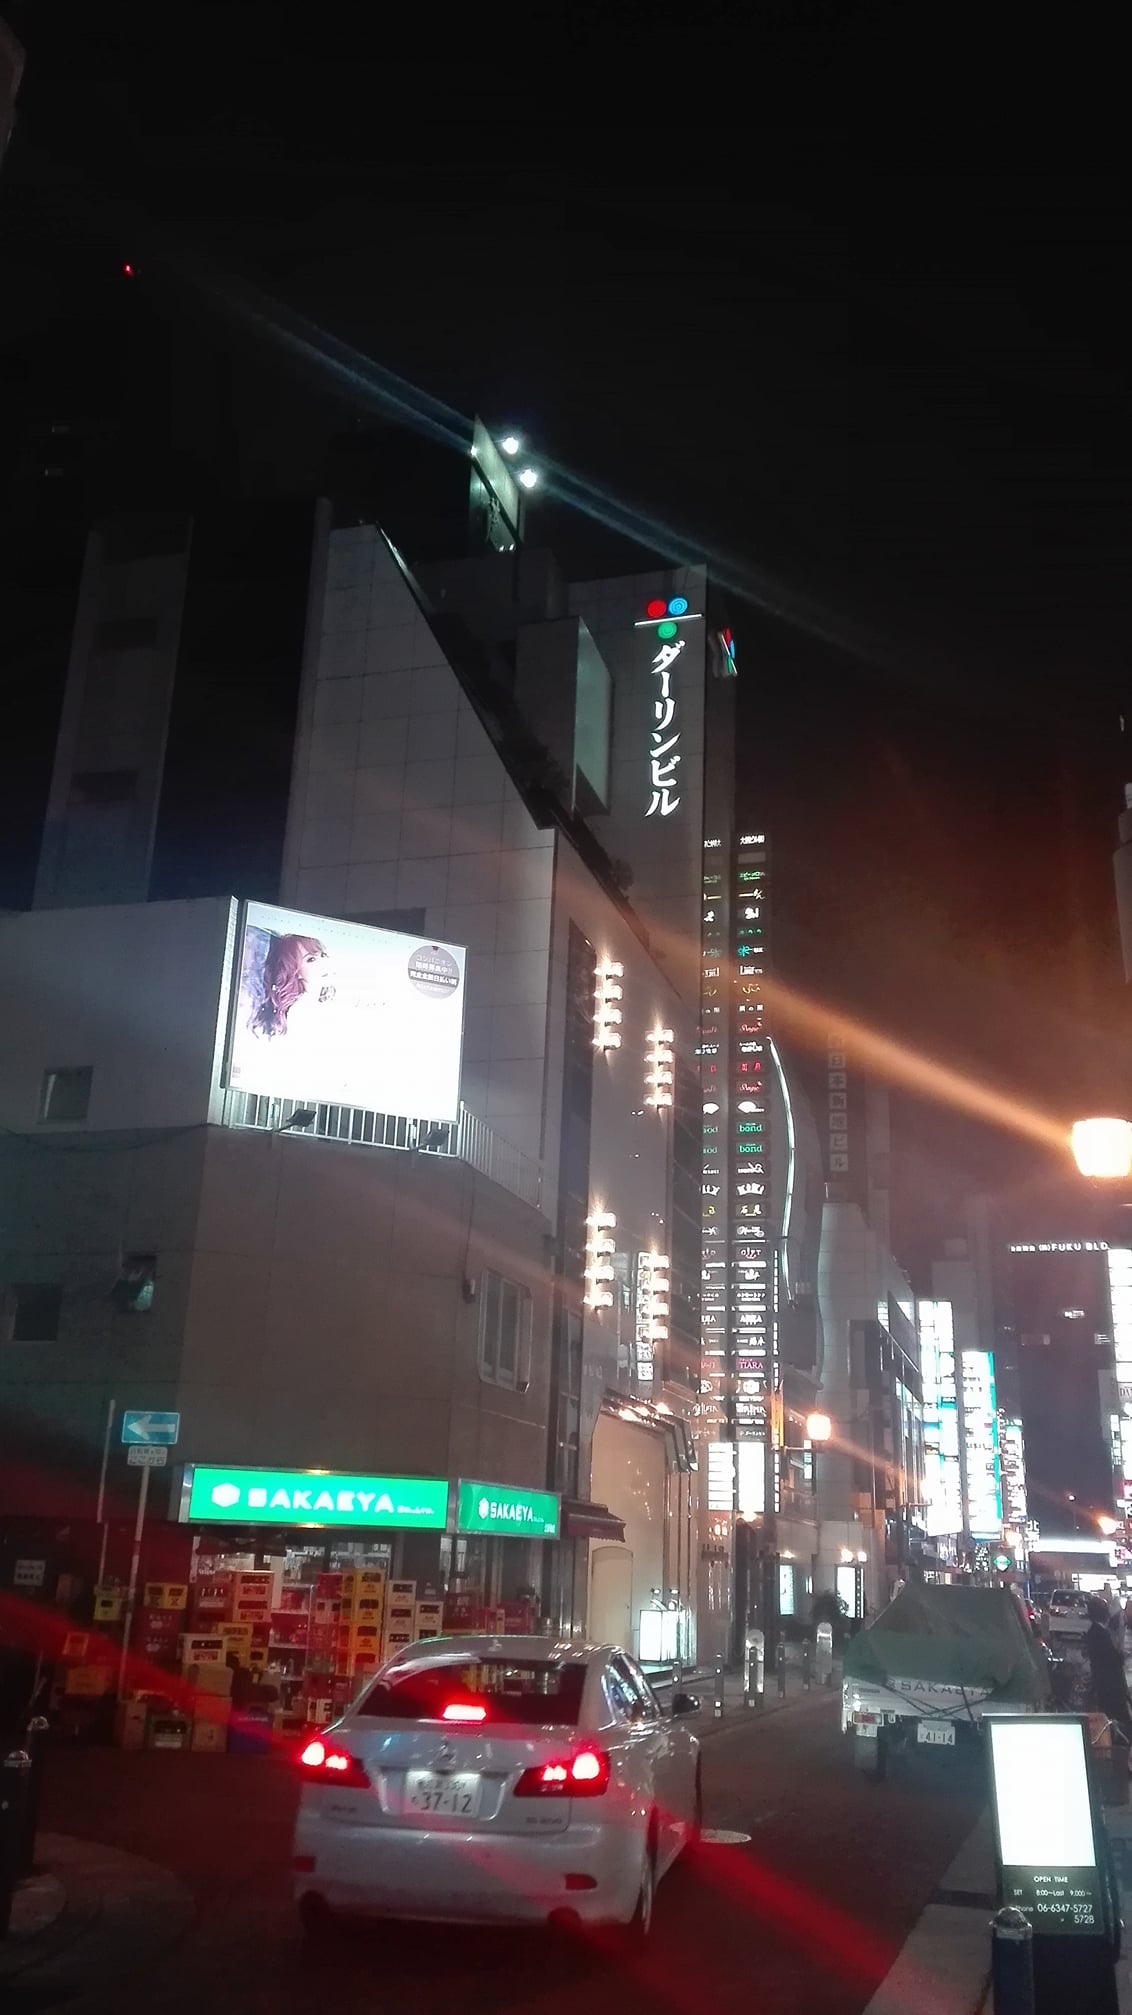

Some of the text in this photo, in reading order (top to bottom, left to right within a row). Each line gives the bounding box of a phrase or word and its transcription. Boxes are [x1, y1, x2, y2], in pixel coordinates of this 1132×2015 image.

[645, 640, 686, 817] ダーリンビル
[248, 1487, 395, 1513] SAKAEYA
[490, 1502, 533, 1522] SAKAEYA
[421, 1791, 473, 1813] 37-12
[1074, 1915, 1095, 1924] 5728
